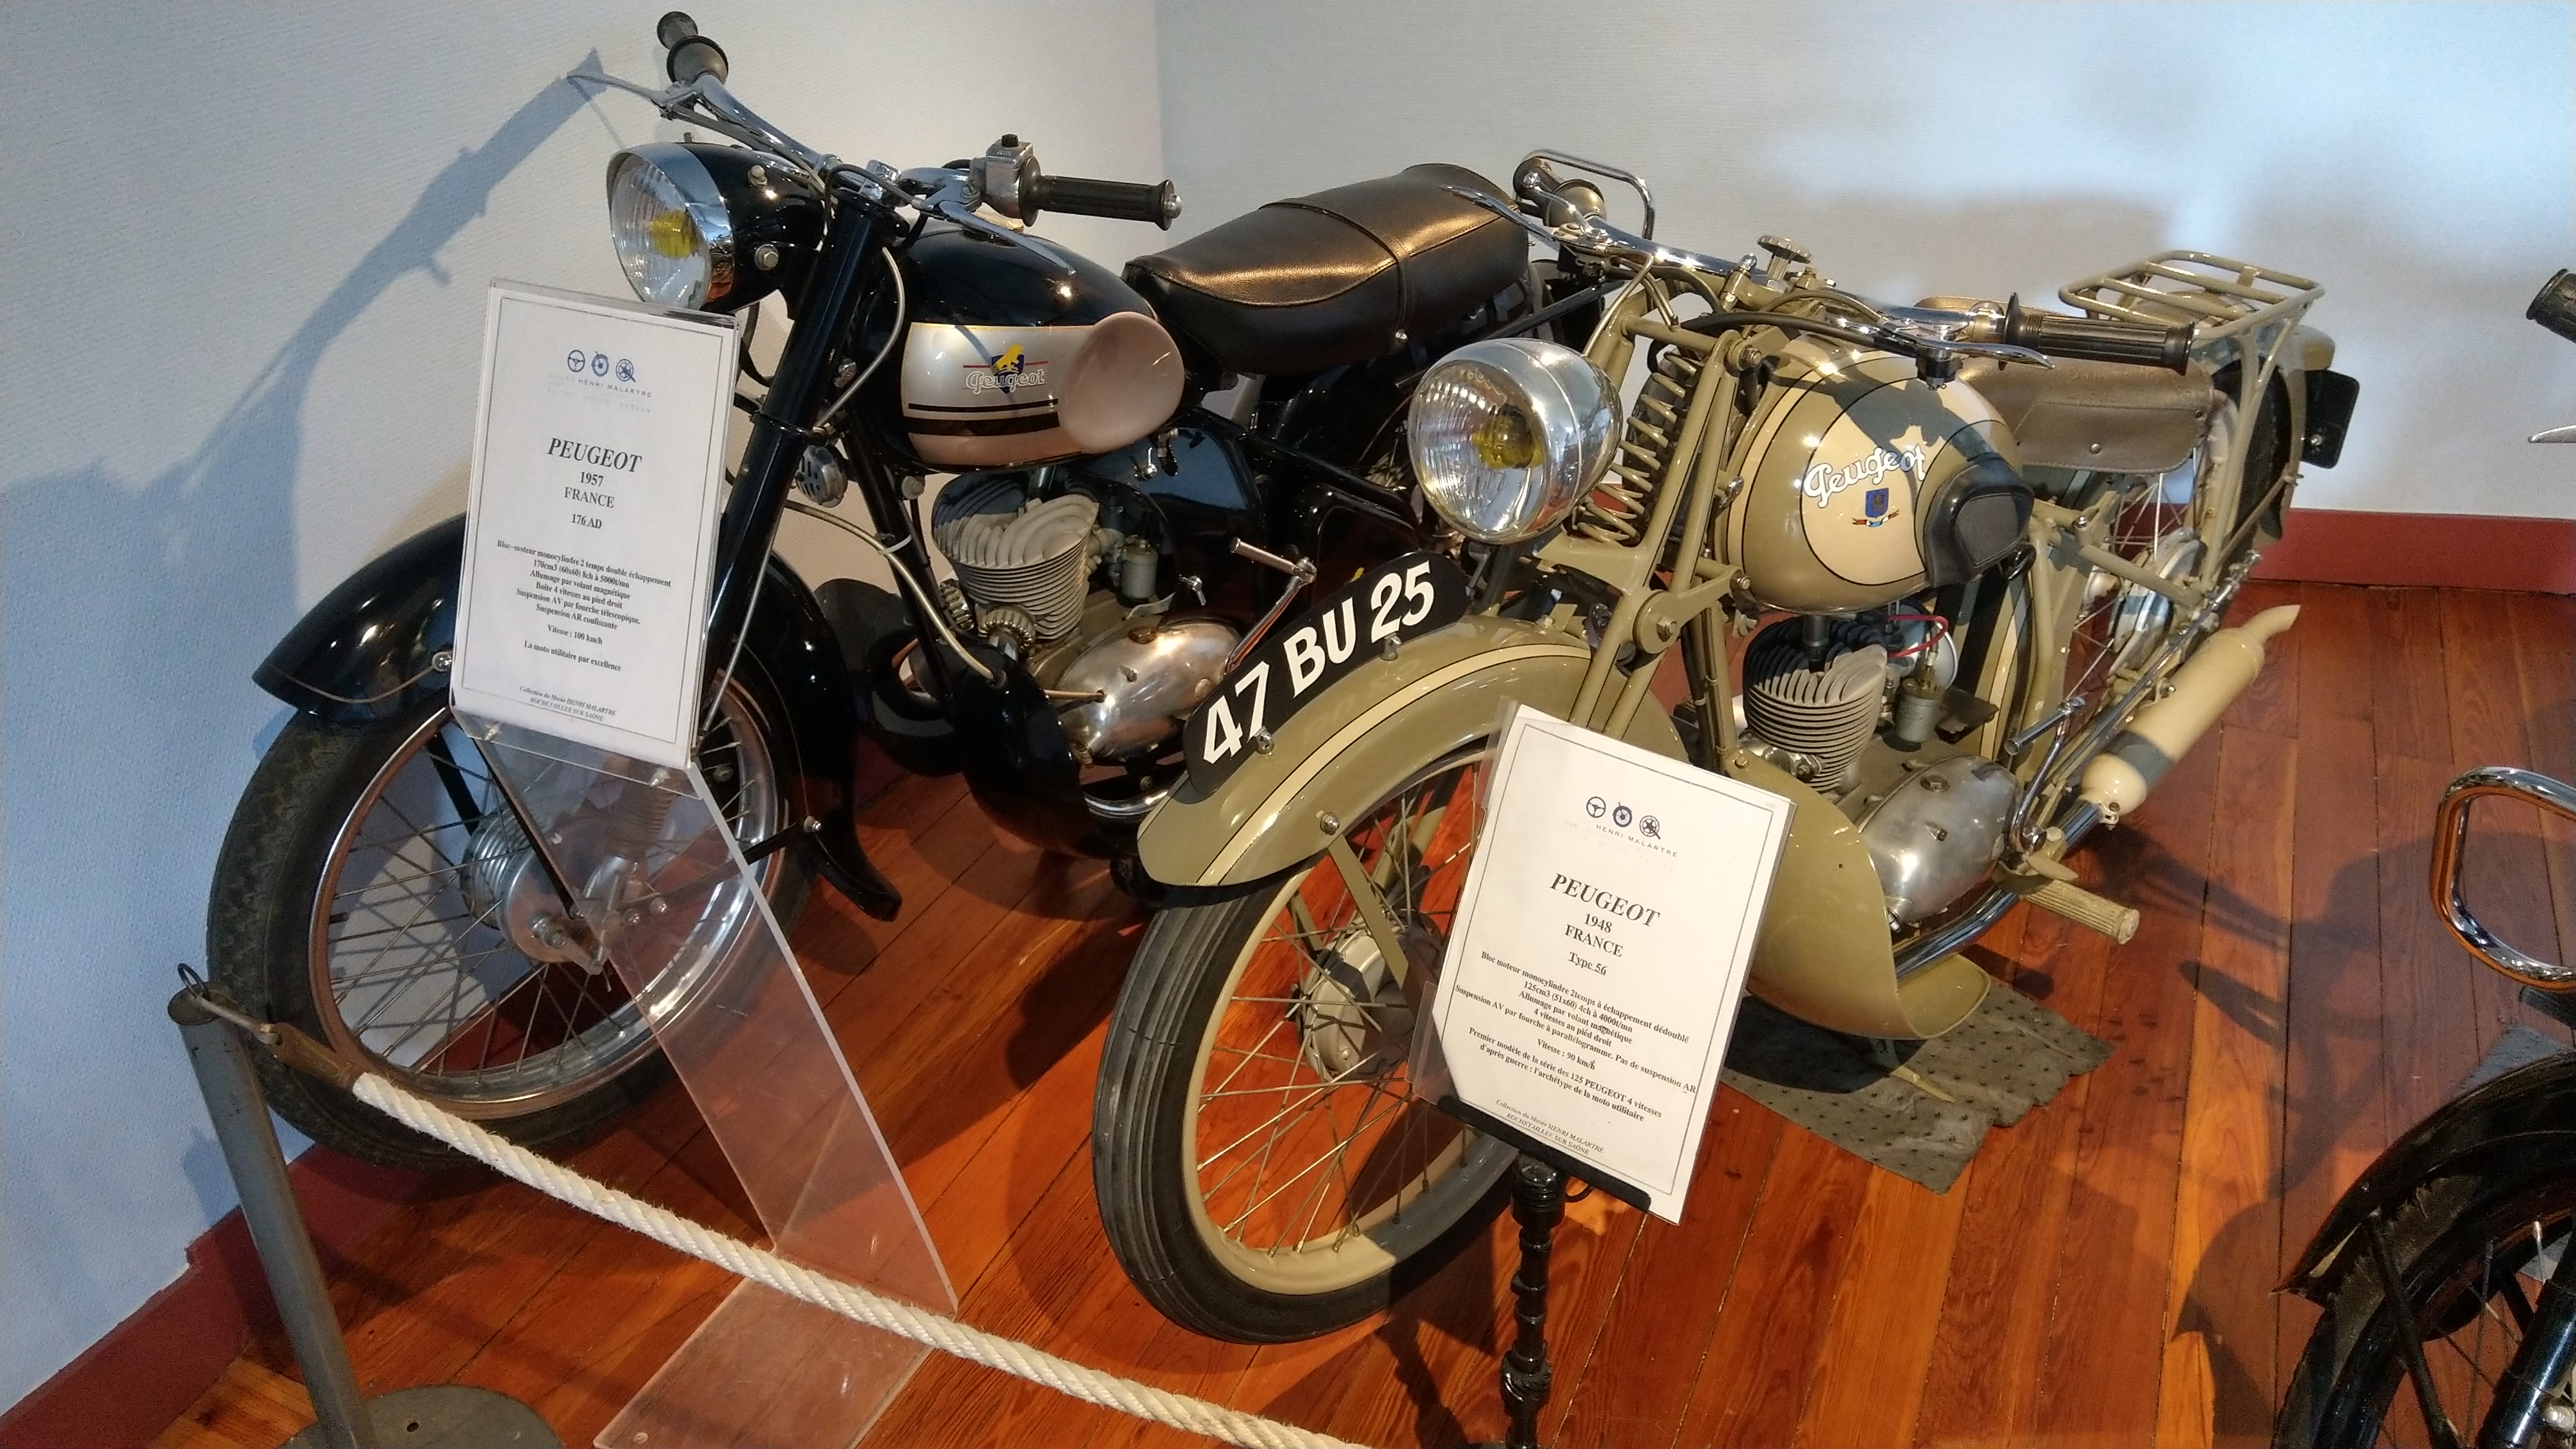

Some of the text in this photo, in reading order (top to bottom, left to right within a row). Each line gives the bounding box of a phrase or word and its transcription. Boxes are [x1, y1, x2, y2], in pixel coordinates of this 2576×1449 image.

[578, 379, 651, 397] HENRI MALARTRE
[966, 369, 1046, 394] Peugeot
[547, 437, 642, 473] PEUGEOT
[580, 471, 604, 487] 1957
[1803, 444, 1926, 507] Peugeot
[564, 486, 614, 508] FRANCE
[571, 513, 602, 529] 176 AD
[529, 569, 630, 600] Allumage par volant magnétique
[533, 559, 557, 571] 170cm3
[558, 565, 581, 578] (60x60)
[582, 570, 593, 580] 8ch
[600, 574, 629, 589] 5000t/mn
[536, 551, 580, 565] monocylindre
[580, 558, 584, 567] 2
[585, 560, 605, 573] temps
[605, 565, 628, 576] double
[628, 570, 671, 587] échappement
[515, 587, 550, 603] Suspension
[551, 596, 563, 605] AV
[563, 600, 574, 609] par
[574, 601, 600, 614] fourche
[559, 587, 581, 599] vitesses
[591, 595, 605, 605] pied
[606, 598, 623, 609] droit
[535, 603, 618, 630] Suspension AR coulissante
[547, 624, 569, 636] Vitesse
[574, 630, 585, 640] 100
[585, 634, 603, 645] km/h
[524, 639, 533, 649] La
[533, 644, 550, 653] moto
[550, 648, 577, 660] utilitaire
[590, 659, 621, 672] excellence
[1203, 560, 1435, 764] 47 BU 25
[566, 697, 585, 708] HENRI
[585, 703, 616, 716] MALARTRE
[1595, 824, 1624, 838] HENRI
[1627, 835, 1677, 857] MALARTRE
[1549, 873, 1661, 926] PEUGEOT
[1584, 913, 1613, 933] 1948
[1564, 923, 1624, 957] FRANCE
[1567, 951, 1607, 976] Type 56
[1481, 951, 1496, 963] Bloc
[1496, 959, 1521, 974] moteur
[1522, 970, 1569, 994] monocylindre
[1596, 999, 1602, 1009] à
[1603, 1003, 1652, 1029] échappement
[1653, 1024, 1689, 1043] dédoublé
[1524, 981, 1633, 1033] 125cm3 (51x60) 4ch à 4000t/mn
[1518, 990, 1633, 1044] Allumage par volant magnétique
[1540, 1011, 1565, 1027] vitesses
[1566, 1023, 1575, 1032] au
[1593, 1034, 1611, 1047] droit
[1455, 984, 1491, 1006] Suspension
[1491, 1001, 1504, 1010] AV
[1504, 1007, 1518, 1017] par
[1518, 1012, 1545, 1029] fourche
[1551, 1028, 1613, 1059] parallélogramme.
[1615, 1054, 1629, 1065] Pas
[1629, 1061, 1639, 1070] de
[1640, 1066, 1681, 1088] suspension
[1682, 1083, 1696, 1094] AR
[1537, 1038, 1560, 1055] Vitesse
[1566, 1052, 1576, 1061] 90
[1576, 1055, 1596, 1070] km/h
[1468, 1027, 1496, 1044] Premier
[1496, 1041, 1521, 1056] modèle
[1522, 1051, 1531, 1061] de
[1531, 1055, 1539, 1064] la
[1539, 1060, 1556, 1072] série
[1557, 1067, 1569, 1077] des
[1570, 1072, 1584, 1083] 125
[1584, 1078, 1627, 1102] PEUGEOT
[1634, 1101, 1662, 1118] vitesses
[1479, 1043, 1504, 1059] d'après
[1504, 1056, 1528, 1070] guerre
[1533, 1066, 1573, 1090] l'archétype
[1573, 1085, 1582, 1095] de
[1583, 1089, 1590, 1099] la
[1591, 1094, 1610, 1107] moto
[1611, 1103, 1644, 1121] utilitaire
[1548, 1123, 1569, 1137] HENRI
[1568, 1133, 1604, 1153] MALARTRE
[1555, 1135, 1567, 1145] SUR
